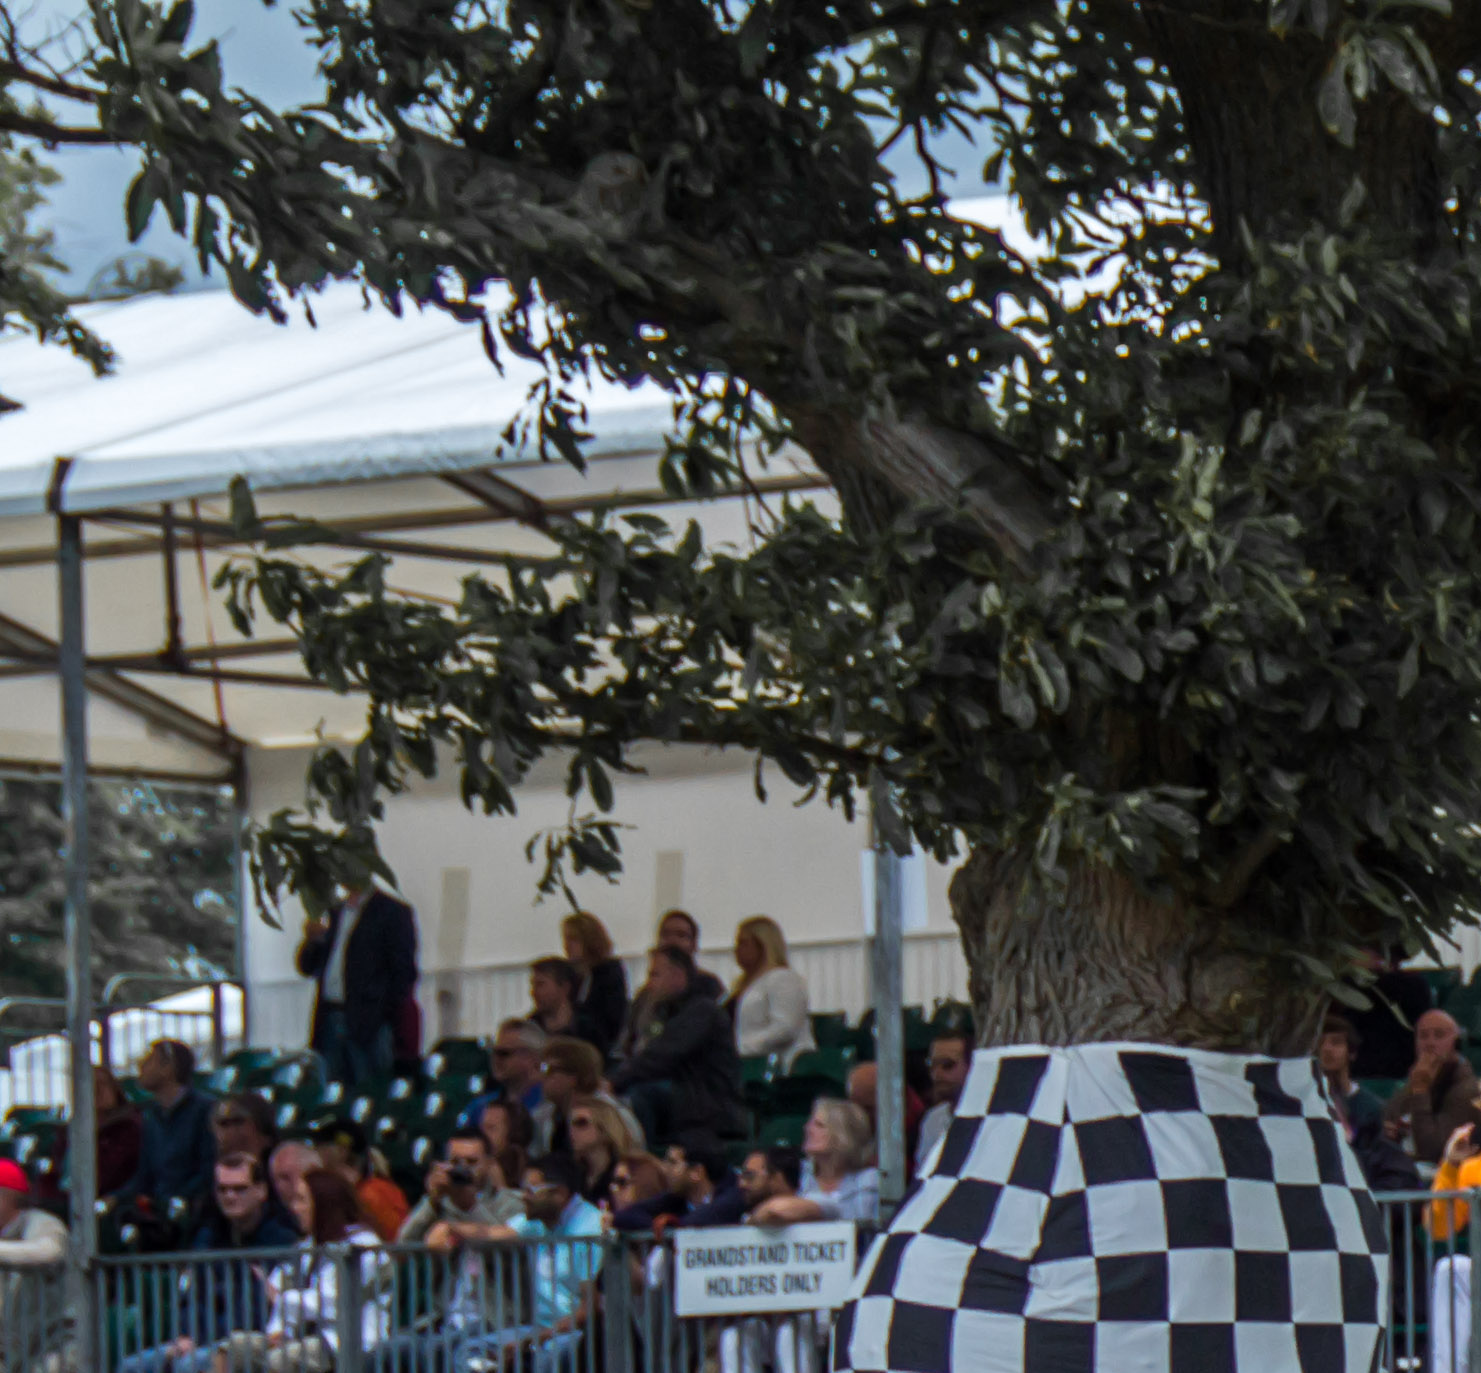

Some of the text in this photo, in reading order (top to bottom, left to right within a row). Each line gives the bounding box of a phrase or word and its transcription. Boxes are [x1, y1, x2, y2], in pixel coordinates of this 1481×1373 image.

[685, 1242, 846, 1268] GRANDSTAND TICKET
[706, 1273, 822, 1296] HOLDERS ONLY
